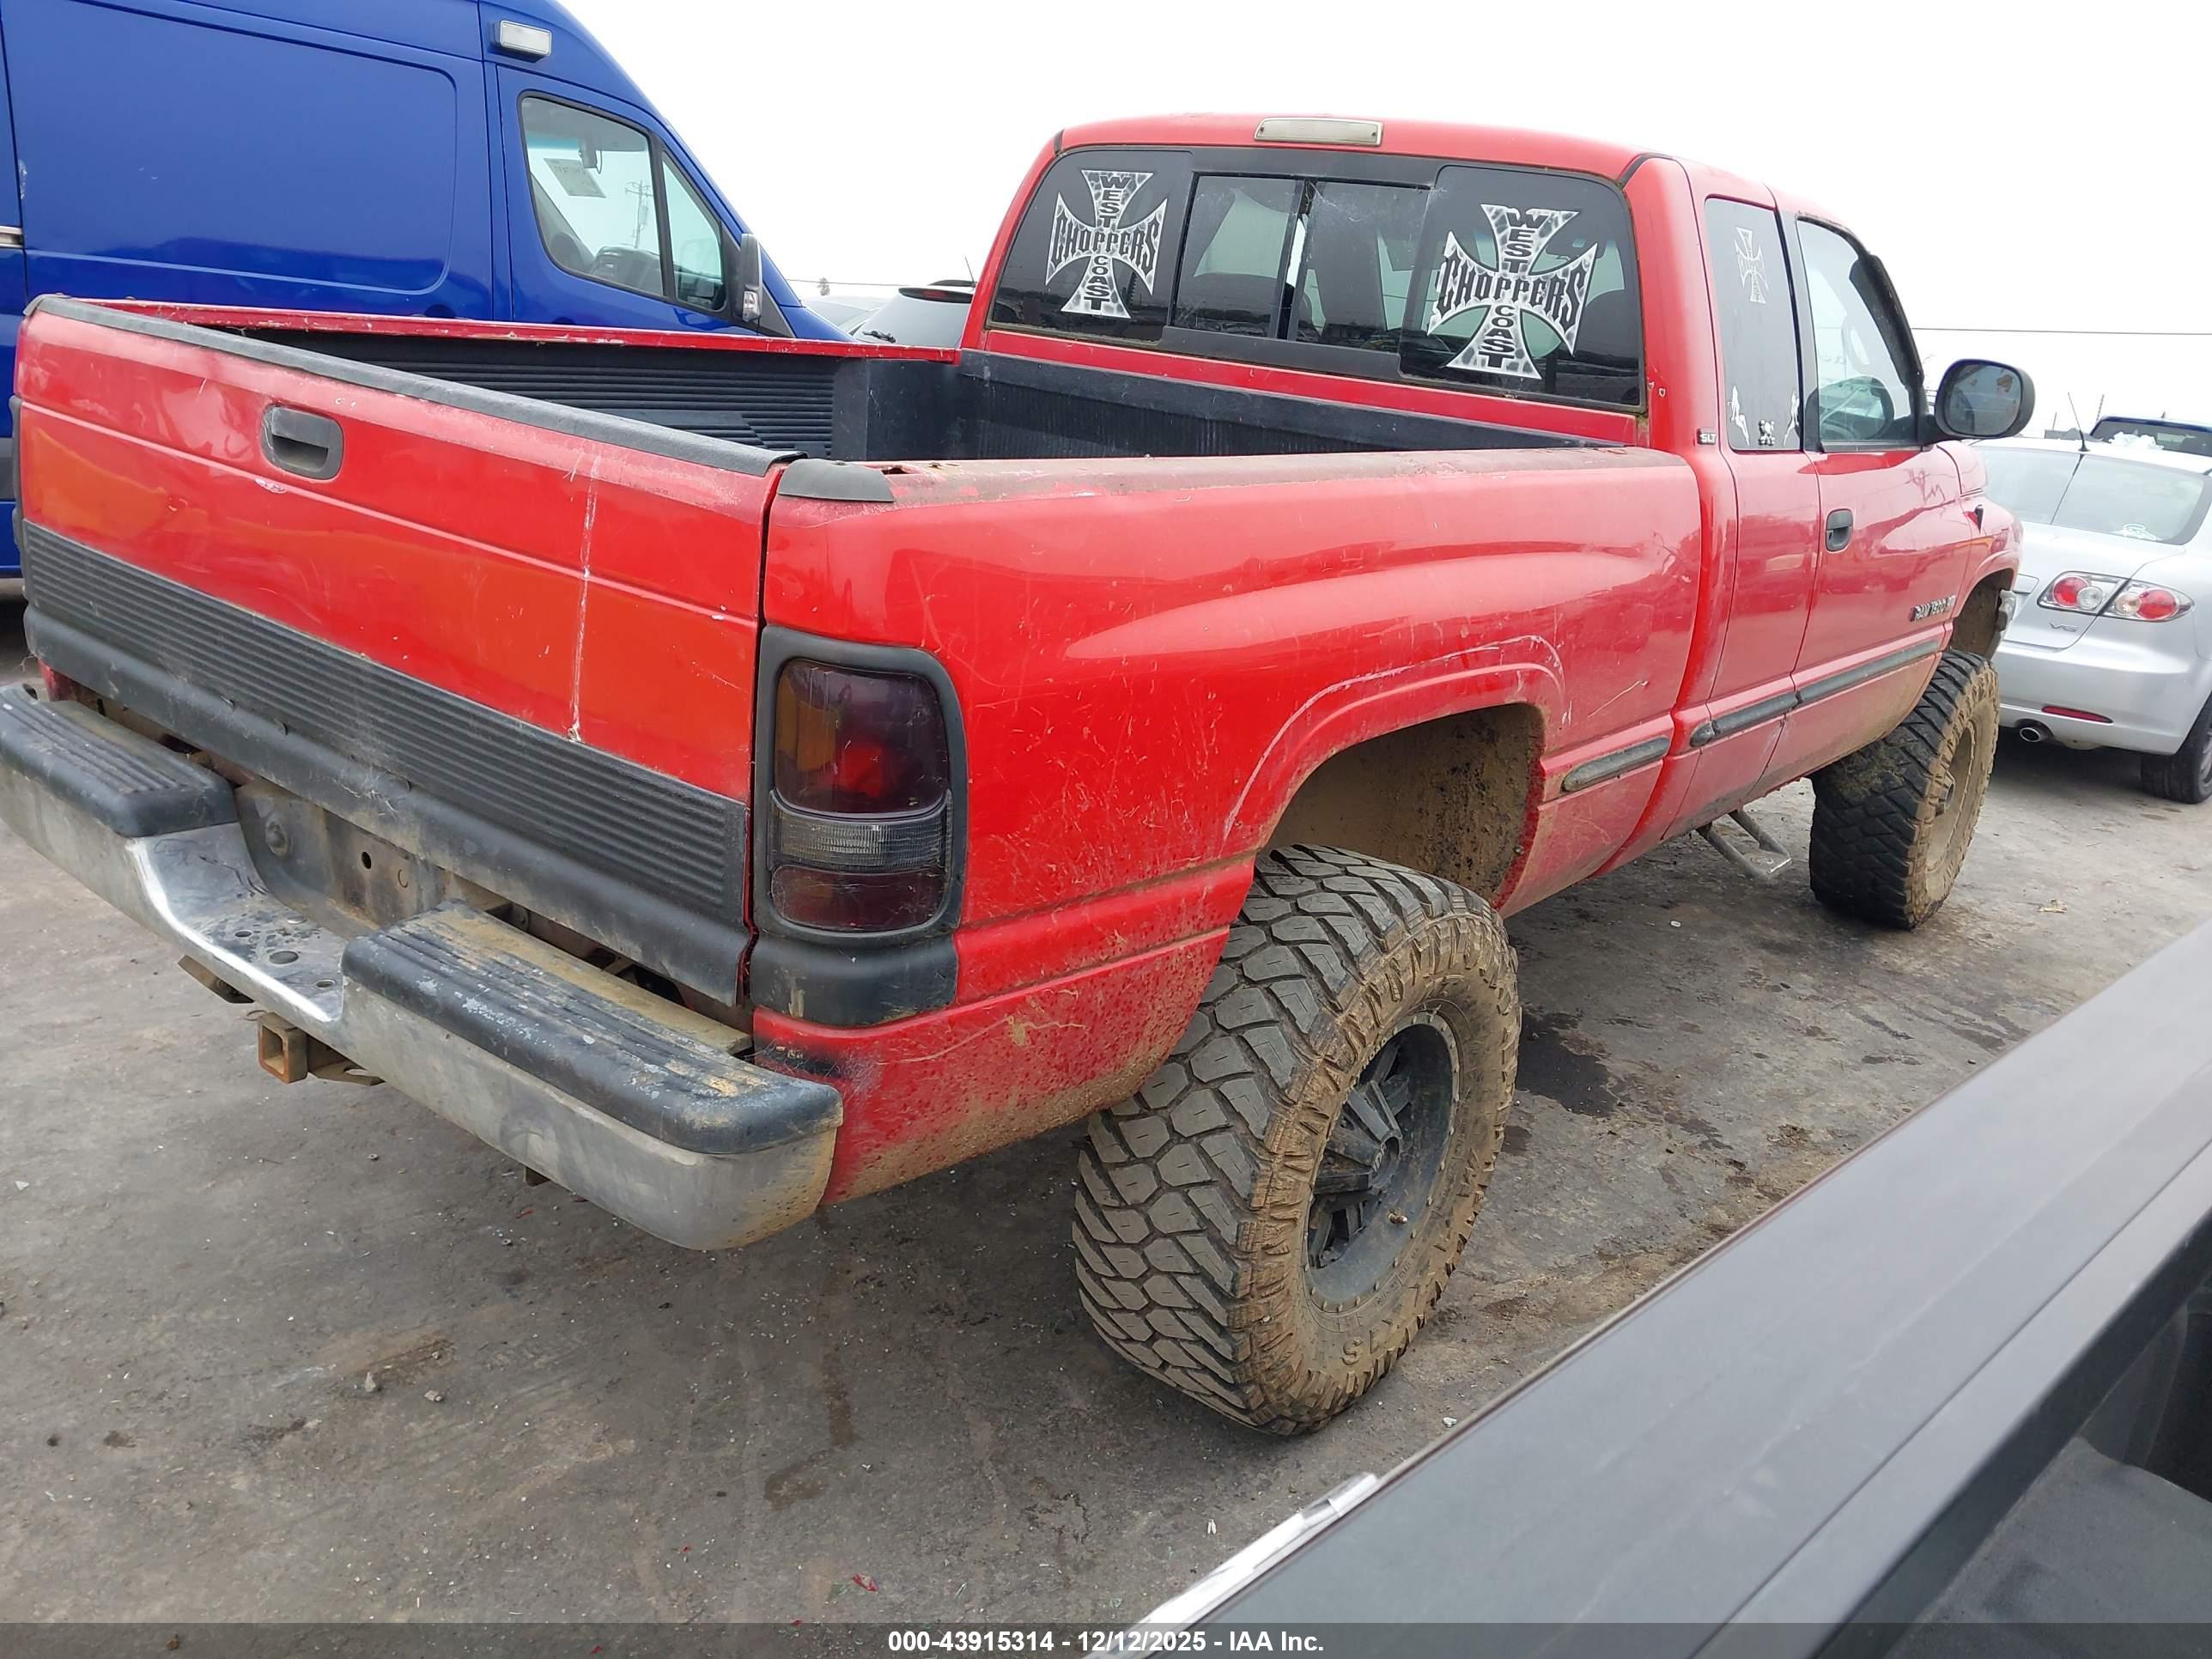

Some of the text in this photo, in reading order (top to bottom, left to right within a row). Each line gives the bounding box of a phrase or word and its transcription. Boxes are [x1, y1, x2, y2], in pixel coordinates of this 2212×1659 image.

[1098, 174, 1131, 228] WEST
[1051, 214, 1161, 276] CHOPPERS
[1504, 211, 1550, 274] WEST
[1083, 255, 1110, 310] COAST
[1435, 253, 1586, 332] CHOPPERS
[1478, 304, 1515, 368] COAST
[1699, 432, 1716, 443] SLT
